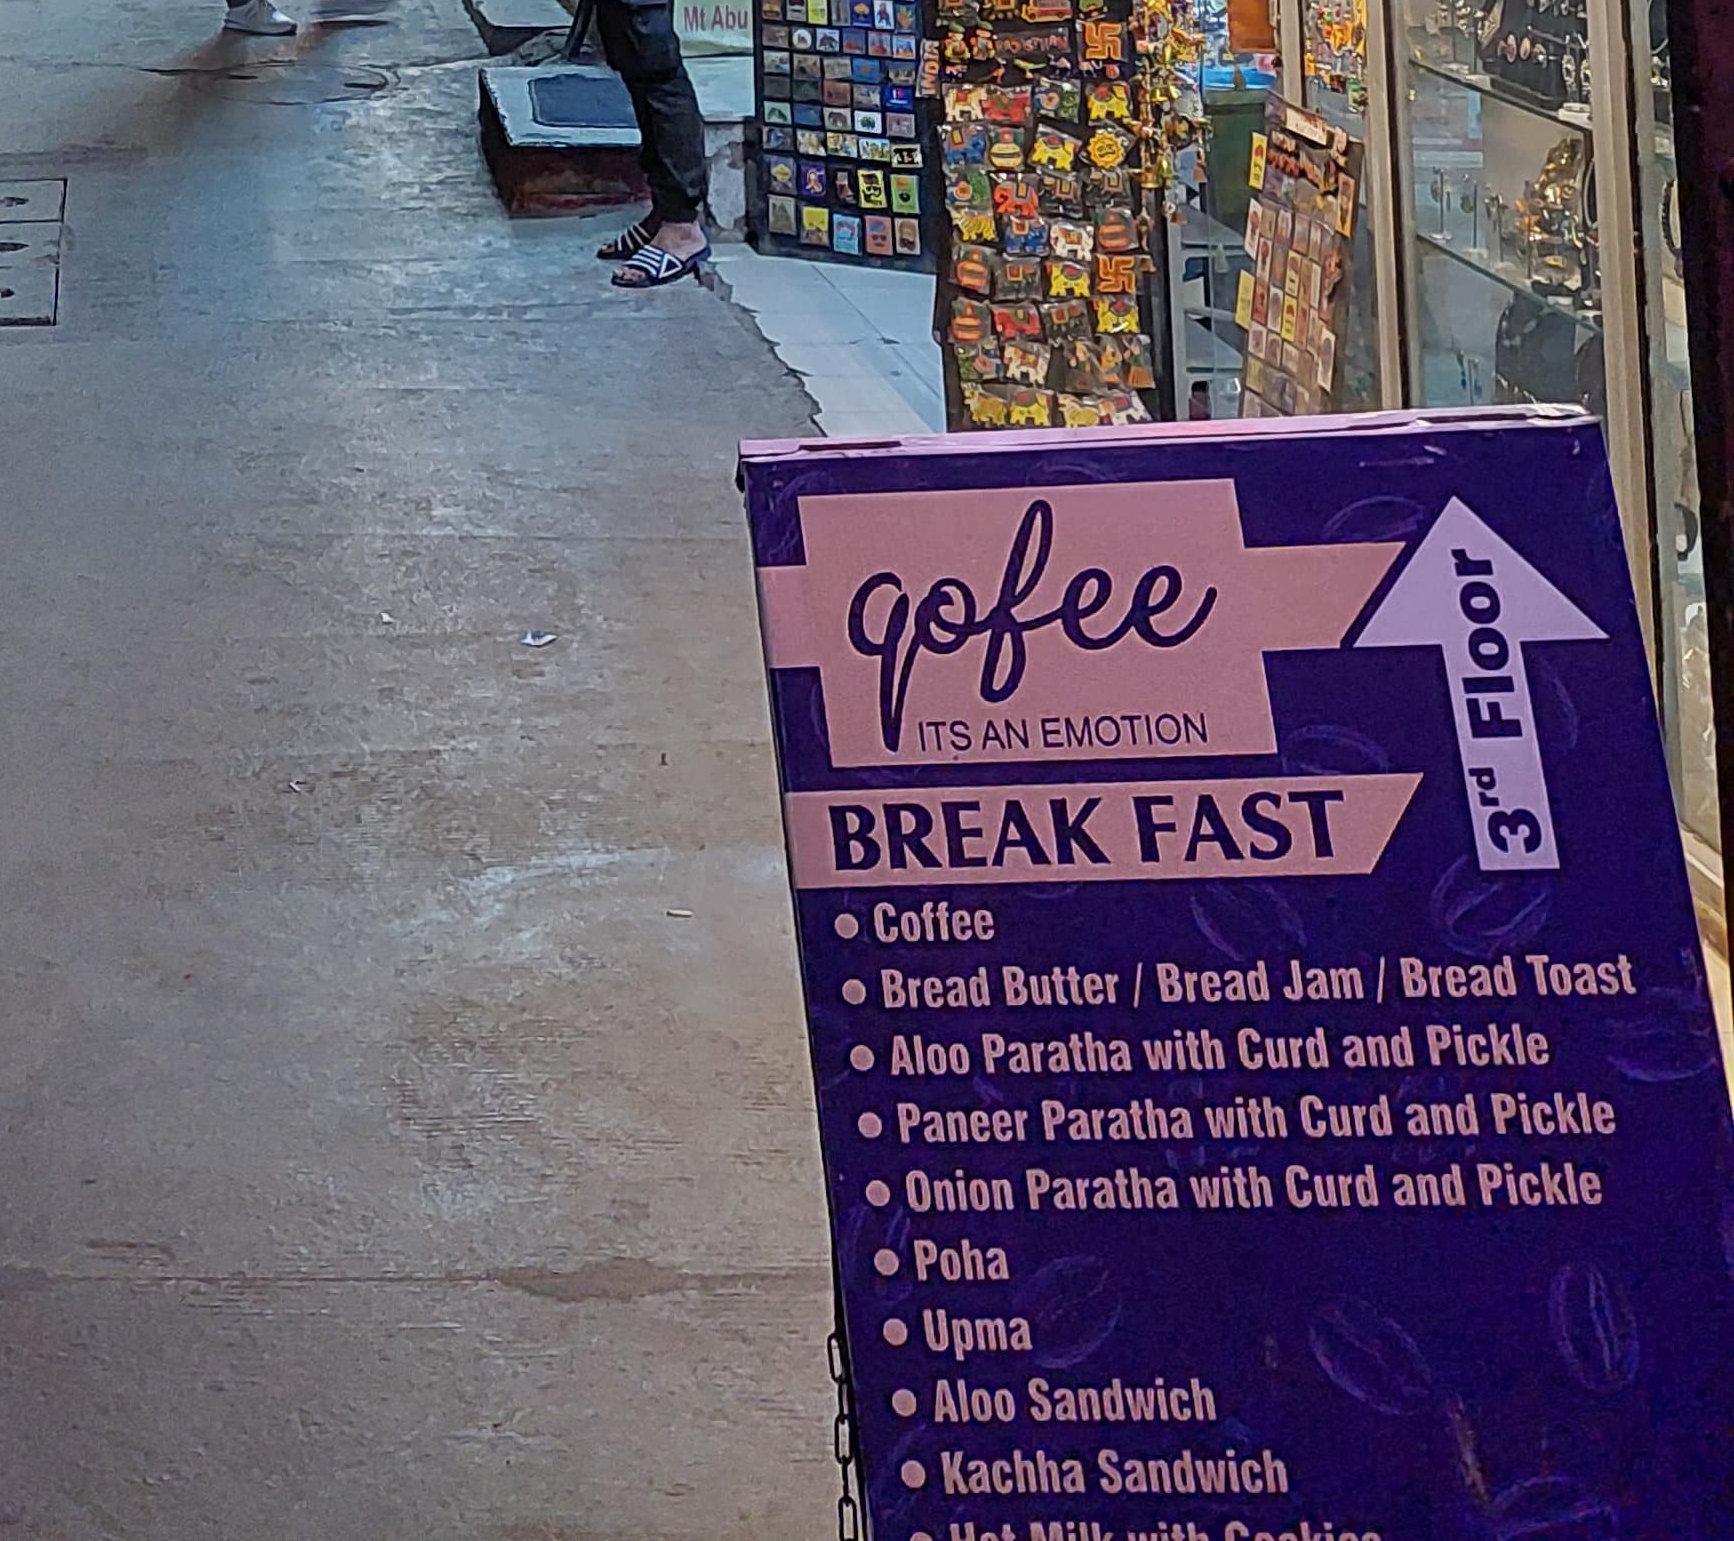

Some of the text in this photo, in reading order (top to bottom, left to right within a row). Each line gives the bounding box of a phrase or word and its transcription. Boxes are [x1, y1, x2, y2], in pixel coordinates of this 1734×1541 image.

[684, 5, 748, 31] Mt Abu
[1451, 548, 1524, 740] Floor
[918, 713, 1208, 751] ITS AN EMOTION
[828, 790, 1344, 871] BREAK FAST
[874, 901, 995, 944] Coffee
[880, 967, 991, 1009] Bread
[1002, 965, 1119, 1006] Butter
[1156, 960, 1270, 1004] Bread
[1282, 959, 1364, 1002] Jam
[1400, 955, 1517, 998] Bread
[1525, 953, 1637, 996] Toast
[890, 1022, 1550, 1076] Aloo Paratha with Curd and Pickle
[896, 1092, 1616, 1144] Paneer Paratha with Curd and Pickle
[905, 1162, 1603, 1213] Onion Paratha with Curd and Pickle
[914, 1239, 1010, 1282] Poha
[922, 1309, 1033, 1361] Upma
[934, 1377, 1217, 1423] Aloo Sandwich
[941, 1449, 1289, 1495] Kachha Sandwich
